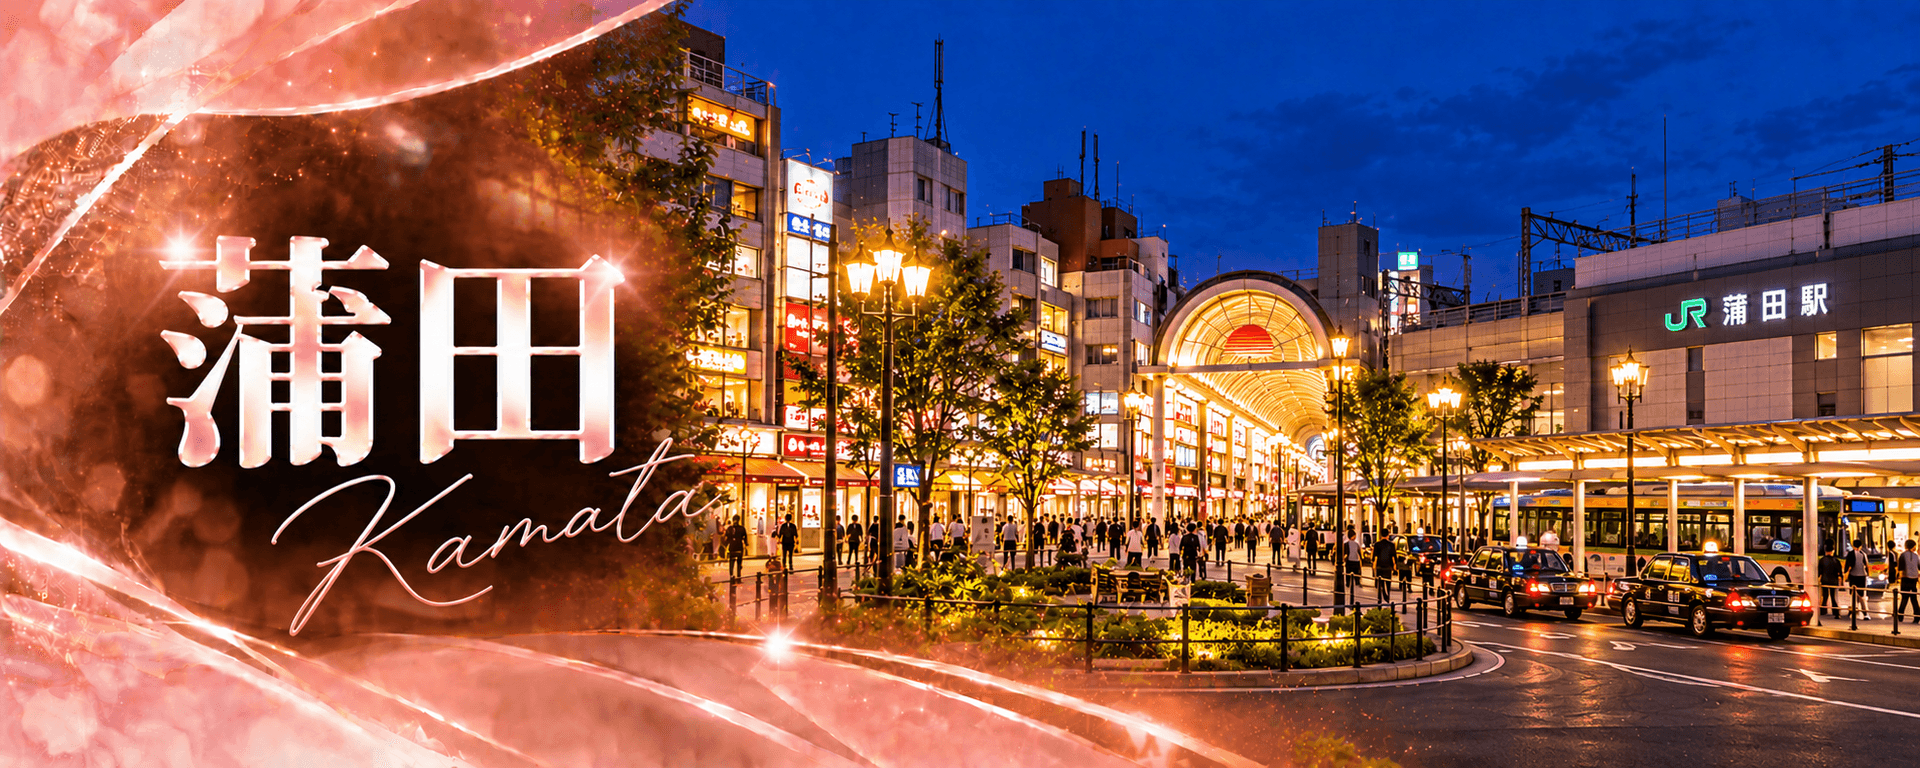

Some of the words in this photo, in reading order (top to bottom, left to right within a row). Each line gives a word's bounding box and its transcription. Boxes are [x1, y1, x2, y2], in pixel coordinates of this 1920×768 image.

[1665, 298, 1706, 331] JR
[1722, 283, 1828, 326] 蒲田駅
